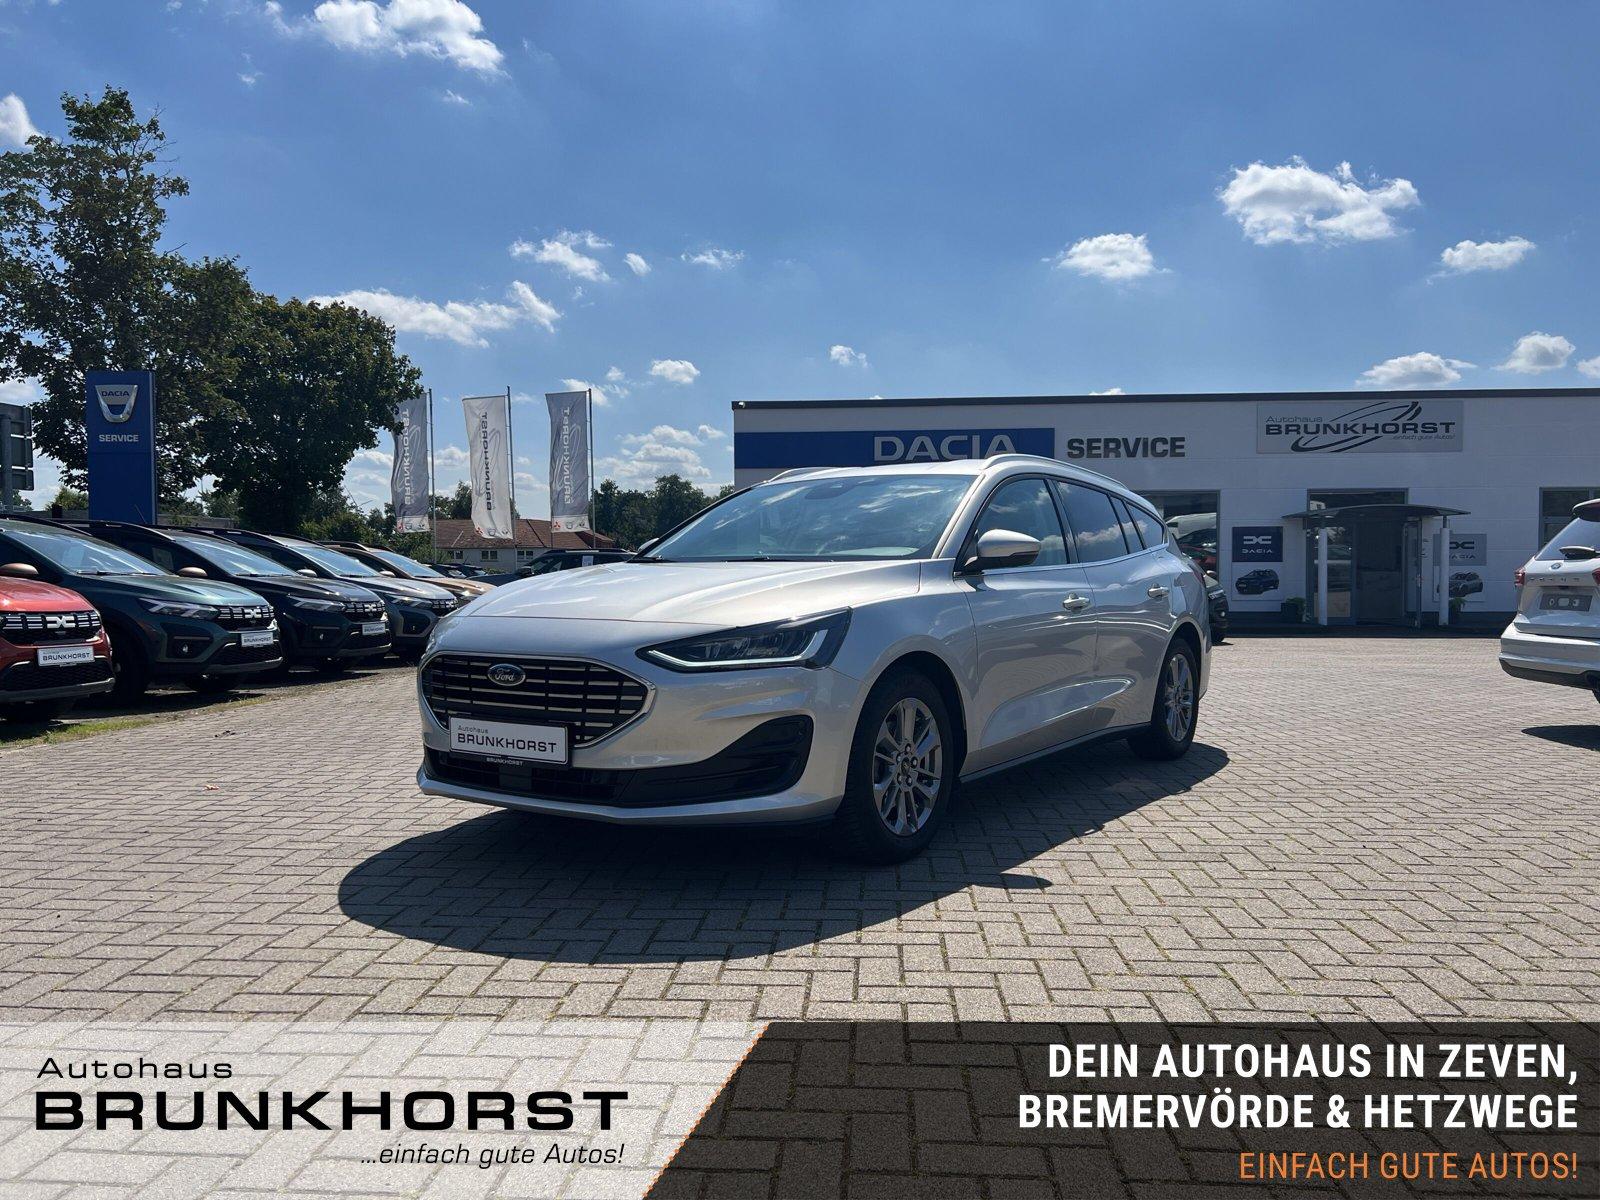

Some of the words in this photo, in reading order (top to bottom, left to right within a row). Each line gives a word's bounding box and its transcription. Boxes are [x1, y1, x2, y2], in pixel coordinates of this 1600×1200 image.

[1265, 415, 1323, 423] Autohaus
[1265, 422, 1456, 436] BRUNKHORST
[98, 434, 139, 442] SERVICE
[873, 434, 1017, 462] DACIA
[1067, 436, 1186, 459] SERVICE
[42, 652, 90, 661] BRUNKHORST
[494, 667, 516, 681] Ford
[457, 725, 489, 734] Autohaus
[457, 732, 557, 753] BRUNKHORST
[486, 757, 524, 766] BRUNKHORST
